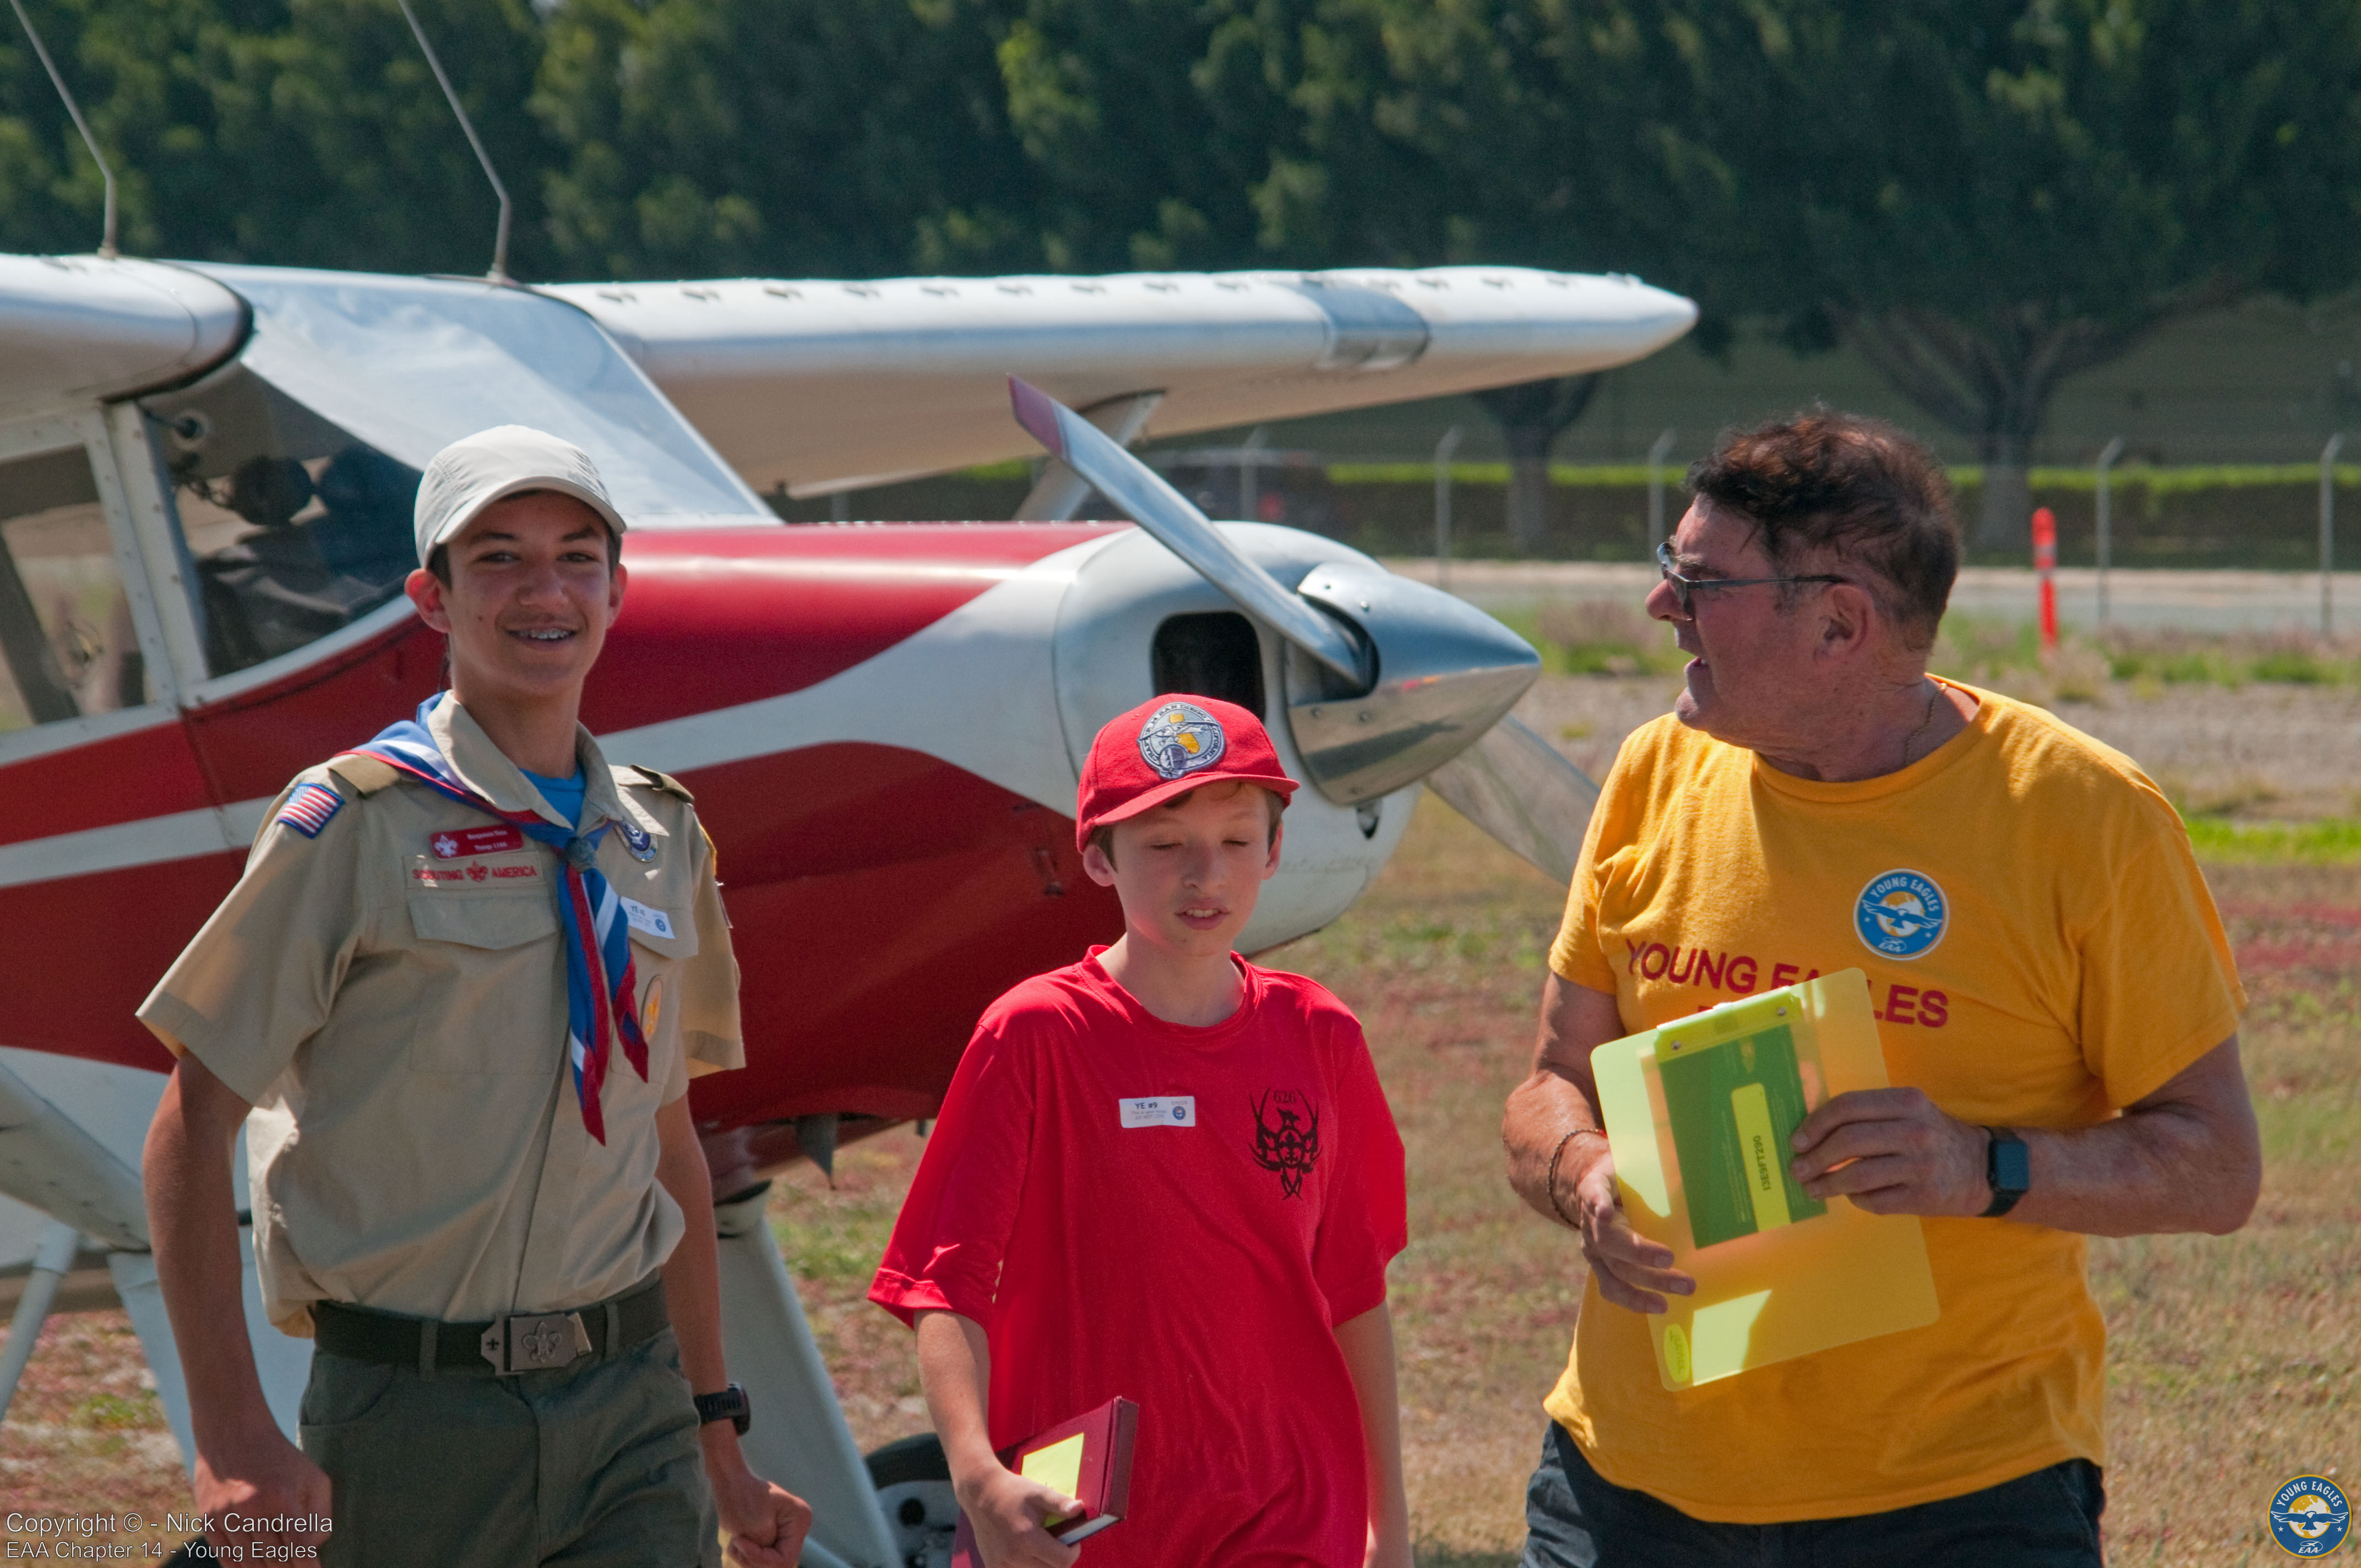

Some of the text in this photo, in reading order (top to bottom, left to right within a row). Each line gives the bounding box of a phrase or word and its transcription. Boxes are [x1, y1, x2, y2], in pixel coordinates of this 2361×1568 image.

[1159, 705, 1177, 716] SAN
[1180, 705, 1206, 718] DIEGO
[412, 865, 537, 880] SCOUTING AMERICA
[1870, 876, 1940, 912] YOUNG EAGLES
[1878, 941, 1902, 952] EAA
[1625, 938, 1758, 993] YOUNG
